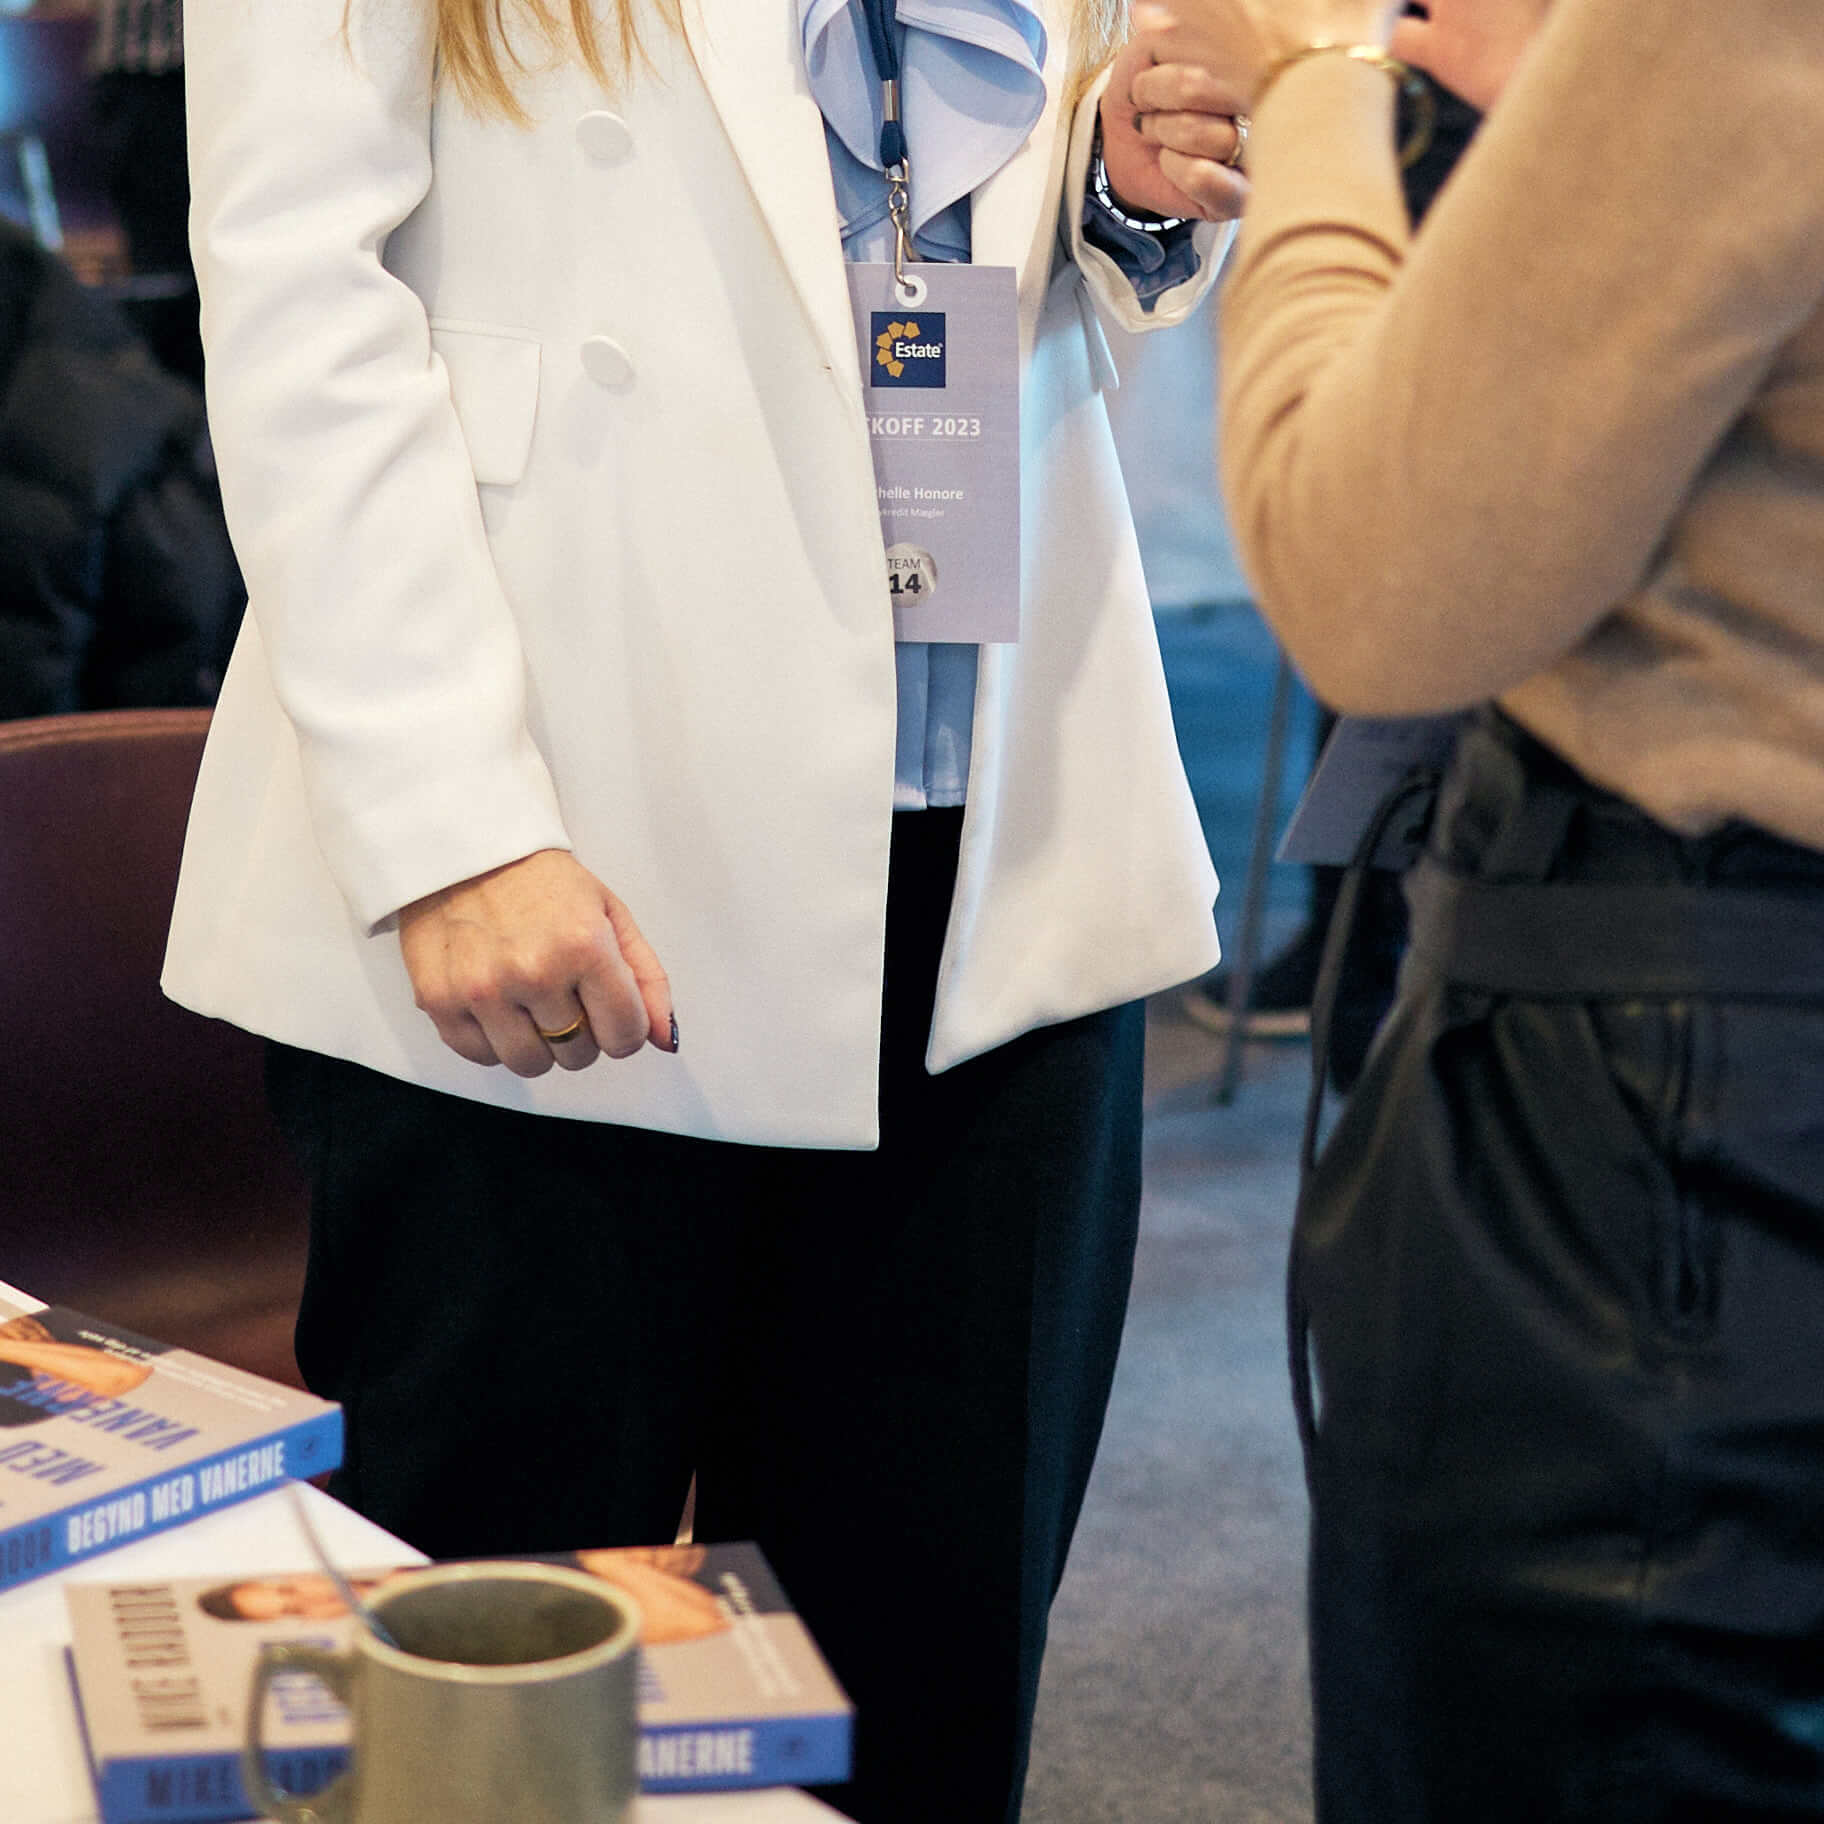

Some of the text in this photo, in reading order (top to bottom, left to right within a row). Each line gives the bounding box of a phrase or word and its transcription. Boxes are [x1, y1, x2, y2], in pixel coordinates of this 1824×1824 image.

[895, 341, 941, 358] Estate
[867, 417, 981, 436] KOFF 2023
[878, 487, 964, 500] helle Honore
[887, 558, 921, 569] TEAM
[888, 573, 922, 594] 14
[66, 1492, 146, 1554] BEGYND
[151, 1474, 195, 1523] MED
[199, 1440, 286, 1506] VANERNE
[639, 1729, 753, 1780] ANERNE
